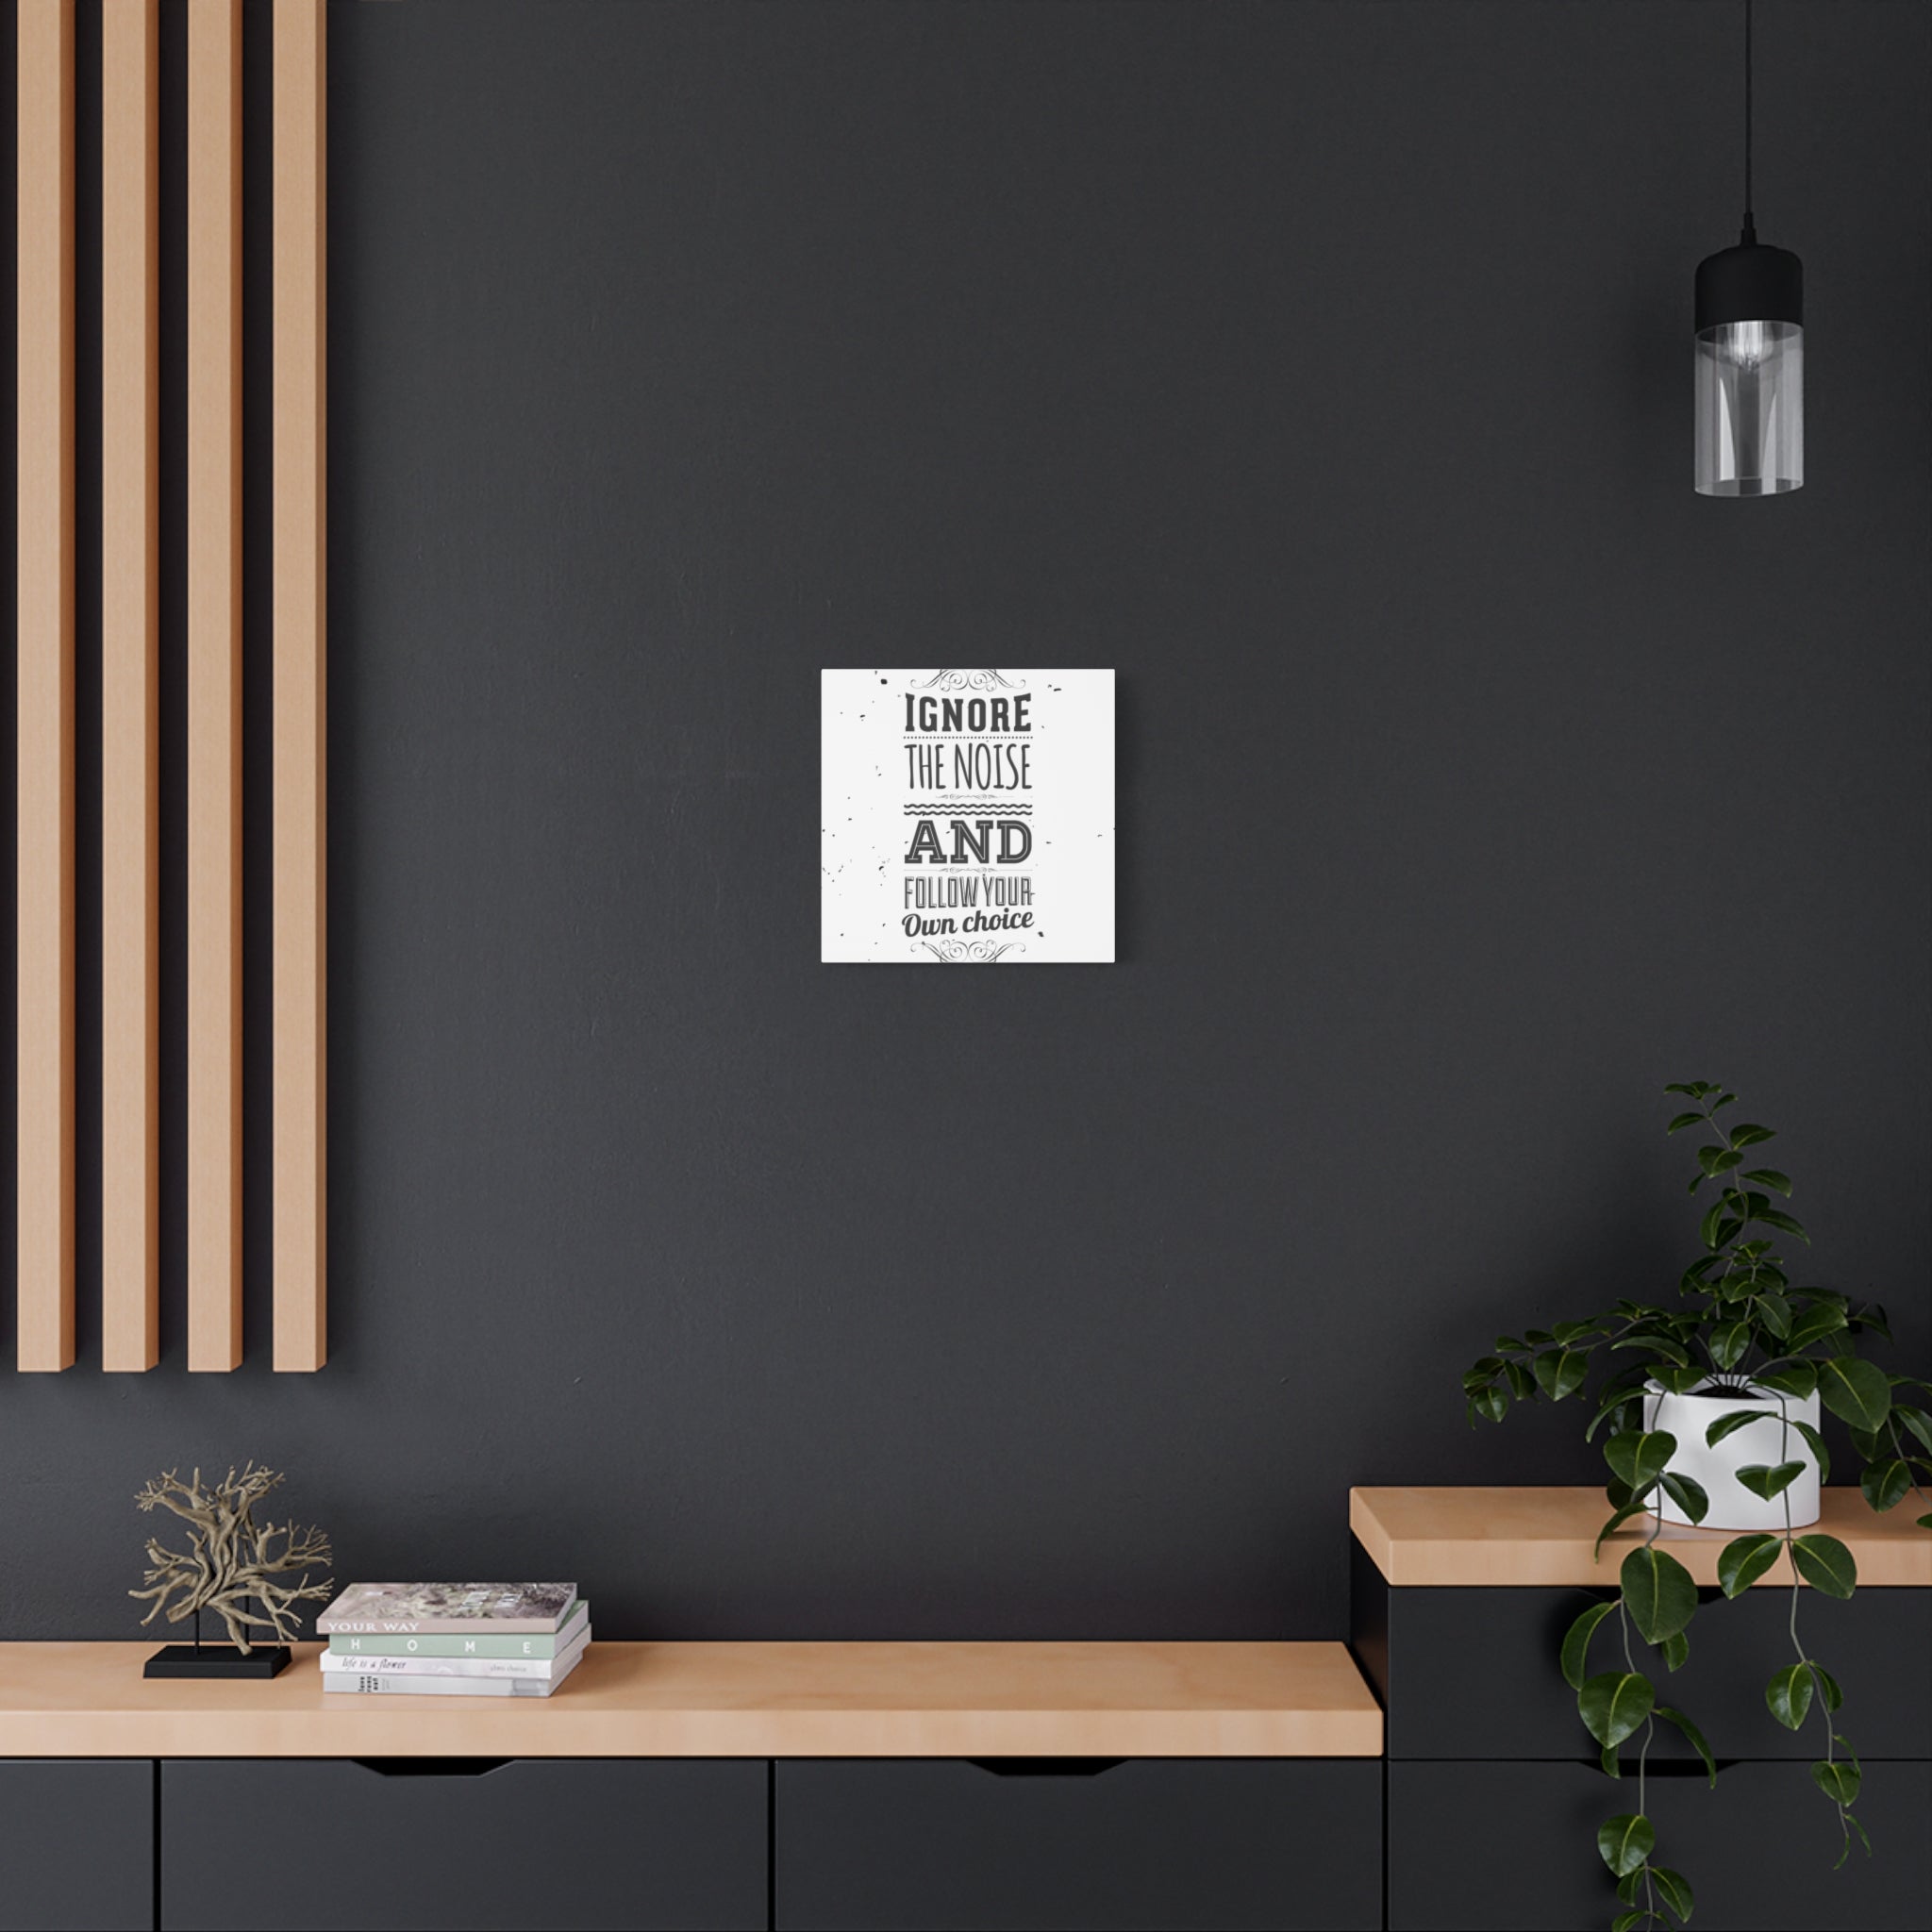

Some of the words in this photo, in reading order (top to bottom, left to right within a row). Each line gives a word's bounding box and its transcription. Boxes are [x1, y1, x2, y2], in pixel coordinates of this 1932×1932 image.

[905, 692, 1032, 732] IGNORE
[904, 743, 946, 790] THE
[955, 742, 1033, 791] NOISE
[904, 820, 1033, 864] AND
[905, 876, 979, 909] FOLLOW
[982, 875, 1033, 907] YOUR
[901, 913, 958, 938] Own
[962, 907, 1035, 934] choice
[328, 1622, 377, 1633] YOUR
[383, 1622, 420, 1633] WAY
[350, 1638, 532, 1654] HOME
[341, 1657, 357, 1671] life
[377, 1657, 407, 1672] flower
